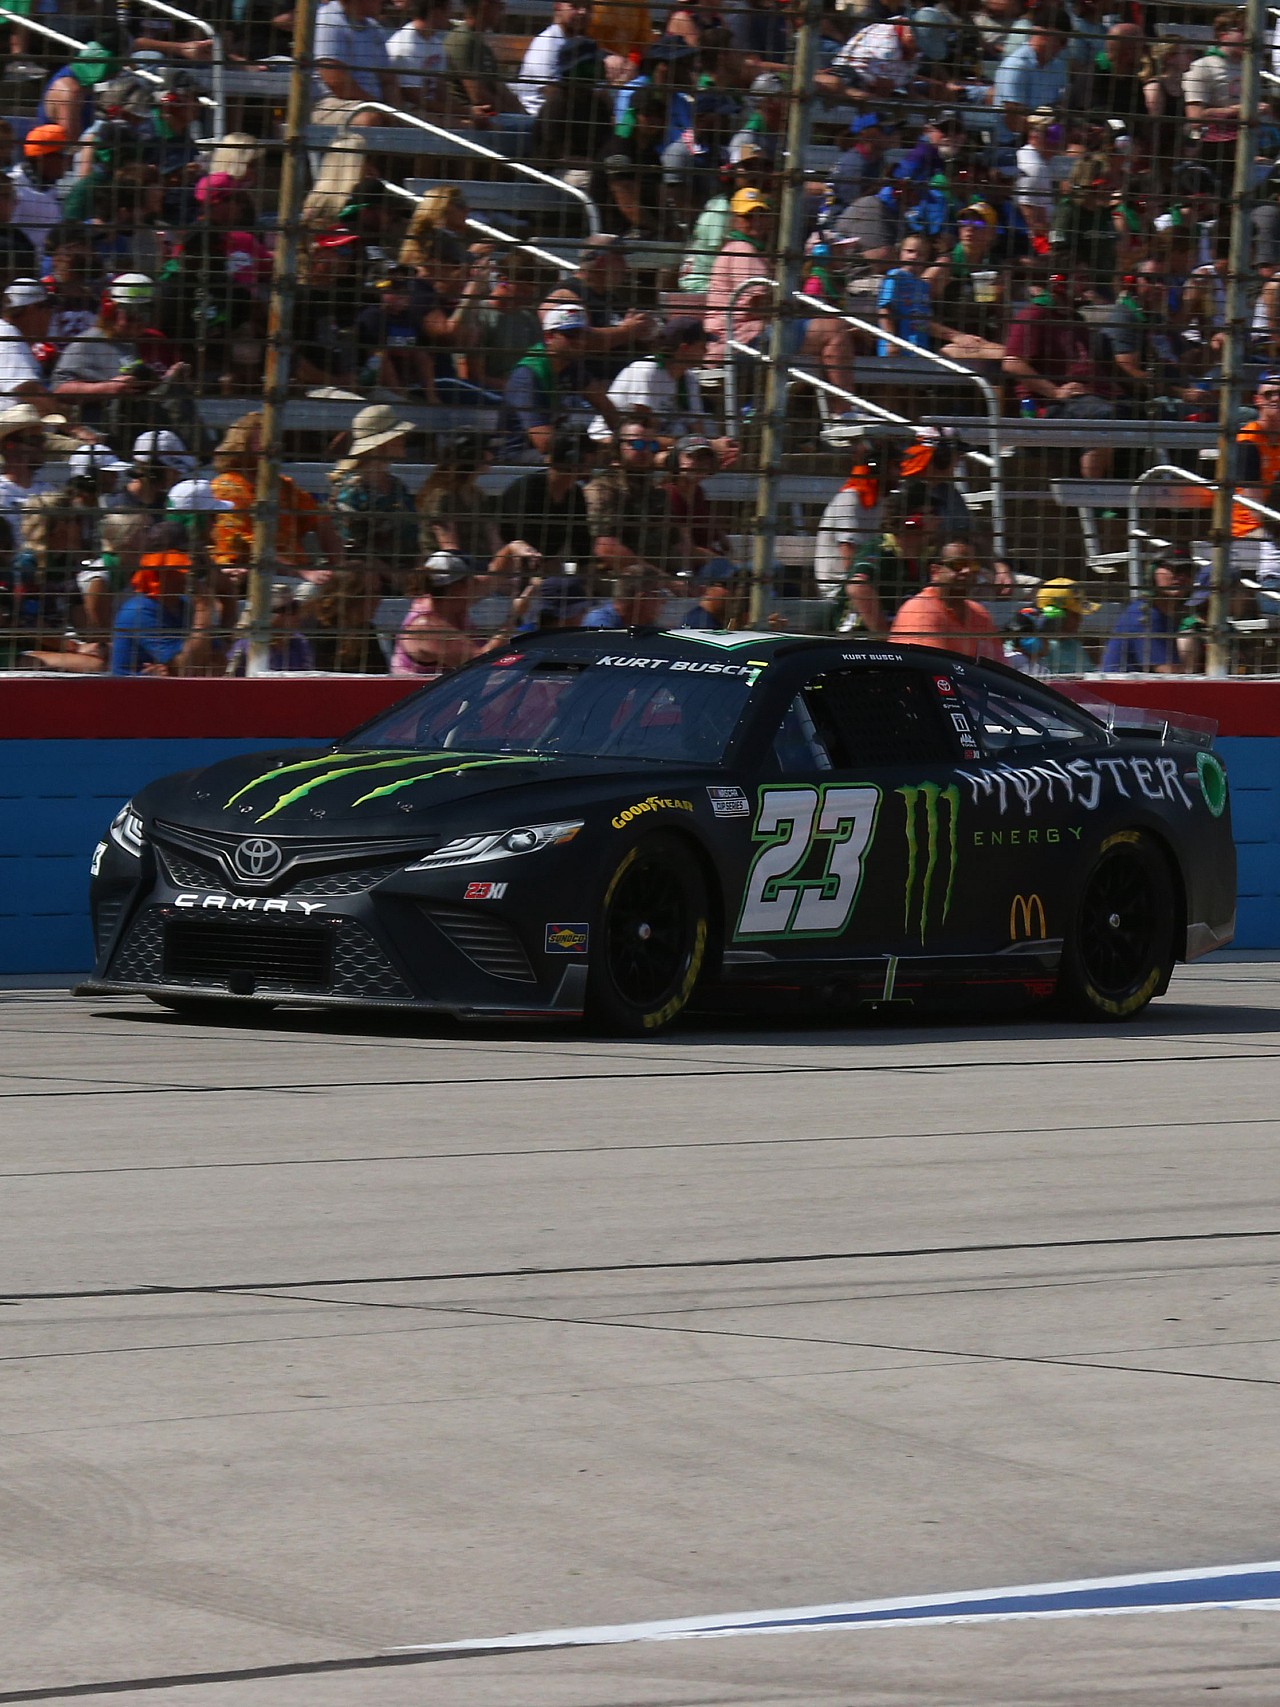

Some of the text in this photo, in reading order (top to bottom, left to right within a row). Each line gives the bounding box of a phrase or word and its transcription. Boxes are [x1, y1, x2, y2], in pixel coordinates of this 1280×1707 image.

[596, 655, 759, 677] KURT BUSCH
[954, 760, 1193, 816] MONSTER
[611, 796, 694, 829] GOODYEAR
[973, 826, 1083, 846] ENERGY
[735, 784, 882, 939] 23
[463, 882, 509, 900] 23XI
[174, 894, 328, 916] CAMRY
[549, 933, 587, 944] SUNOCO
